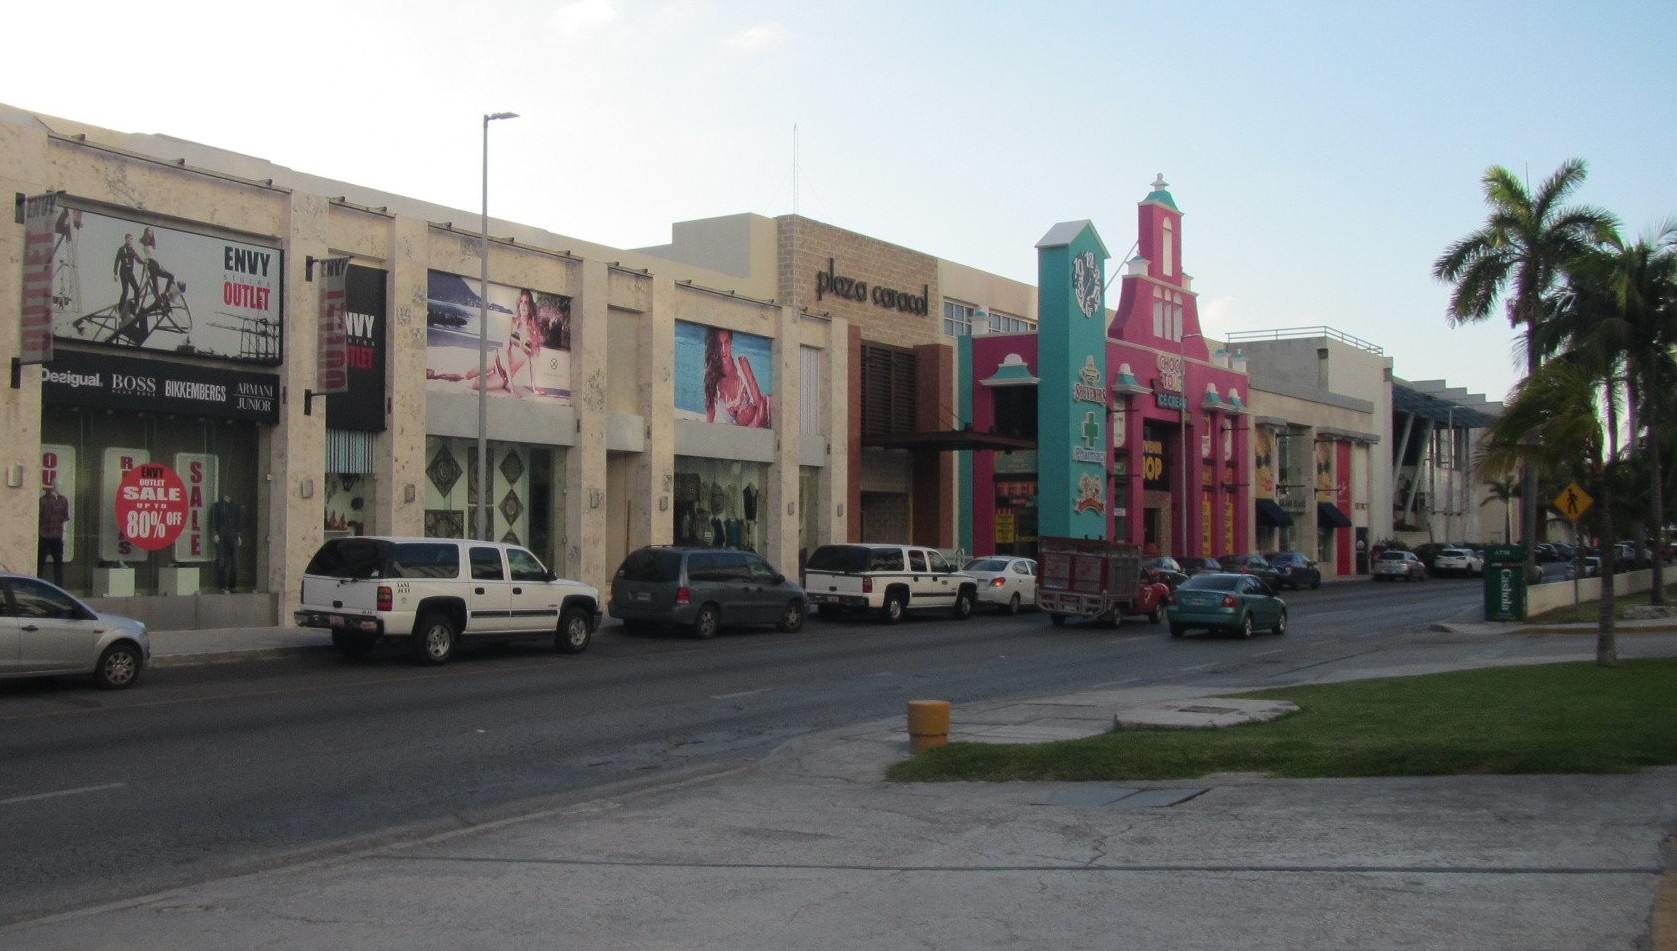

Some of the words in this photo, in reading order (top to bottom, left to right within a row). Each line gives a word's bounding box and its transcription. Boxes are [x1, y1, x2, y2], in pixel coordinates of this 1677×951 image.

[225, 246, 270, 277] ENVY
[224, 281, 270, 311] OUTLET
[816, 257, 867, 302] plaza
[872, 284, 928, 316] caracol
[346, 311, 375, 339] NVY
[347, 338, 375, 347] ores
[112, 374, 156, 393] BOSS
[165, 380, 226, 402] BIKKEMBERGS
[236, 383, 273, 397] ARMANI
[236, 397, 271, 412] JUNIOR
[140, 479, 165, 487] OUTLET
[141, 466, 164, 479] ENVY
[124, 486, 181, 501] SALE
[190, 461, 203, 556] SALE
[127, 510, 166, 538] 80%
[166, 511, 182, 526] OFF
